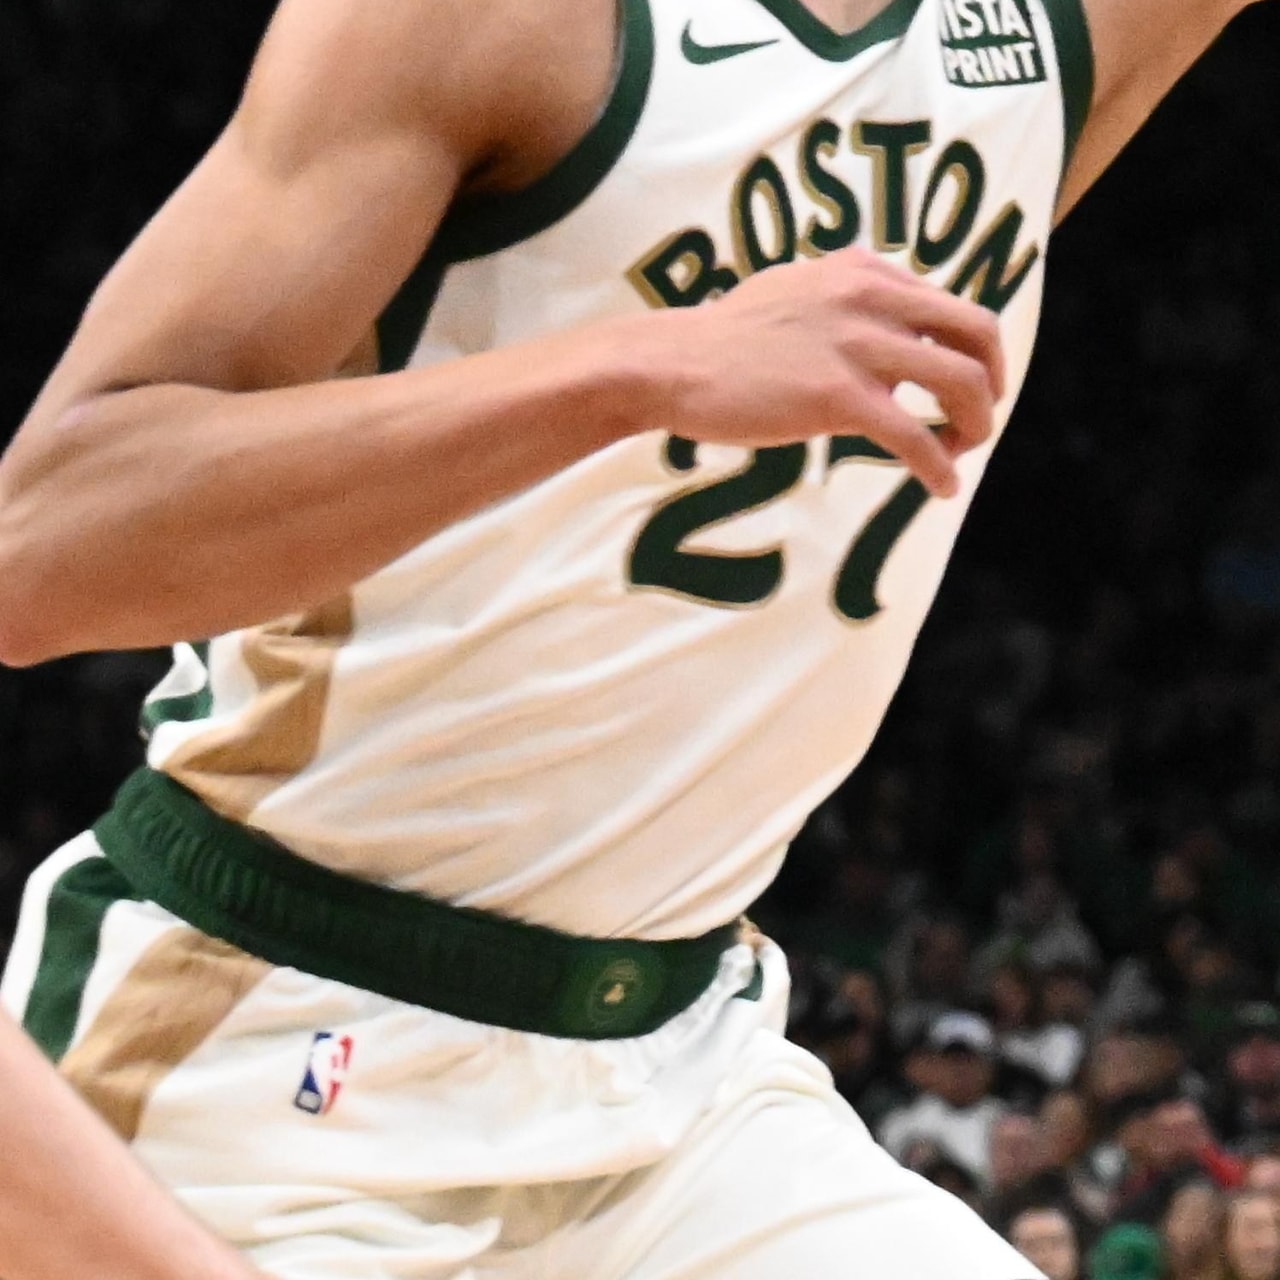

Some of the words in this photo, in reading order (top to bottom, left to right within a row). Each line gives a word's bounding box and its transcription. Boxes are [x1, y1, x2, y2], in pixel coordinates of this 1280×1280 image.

[943, 41, 1037, 83] PRINT
[624, 117, 1040, 314] BOSTON
[625, 417, 948, 623] 27
